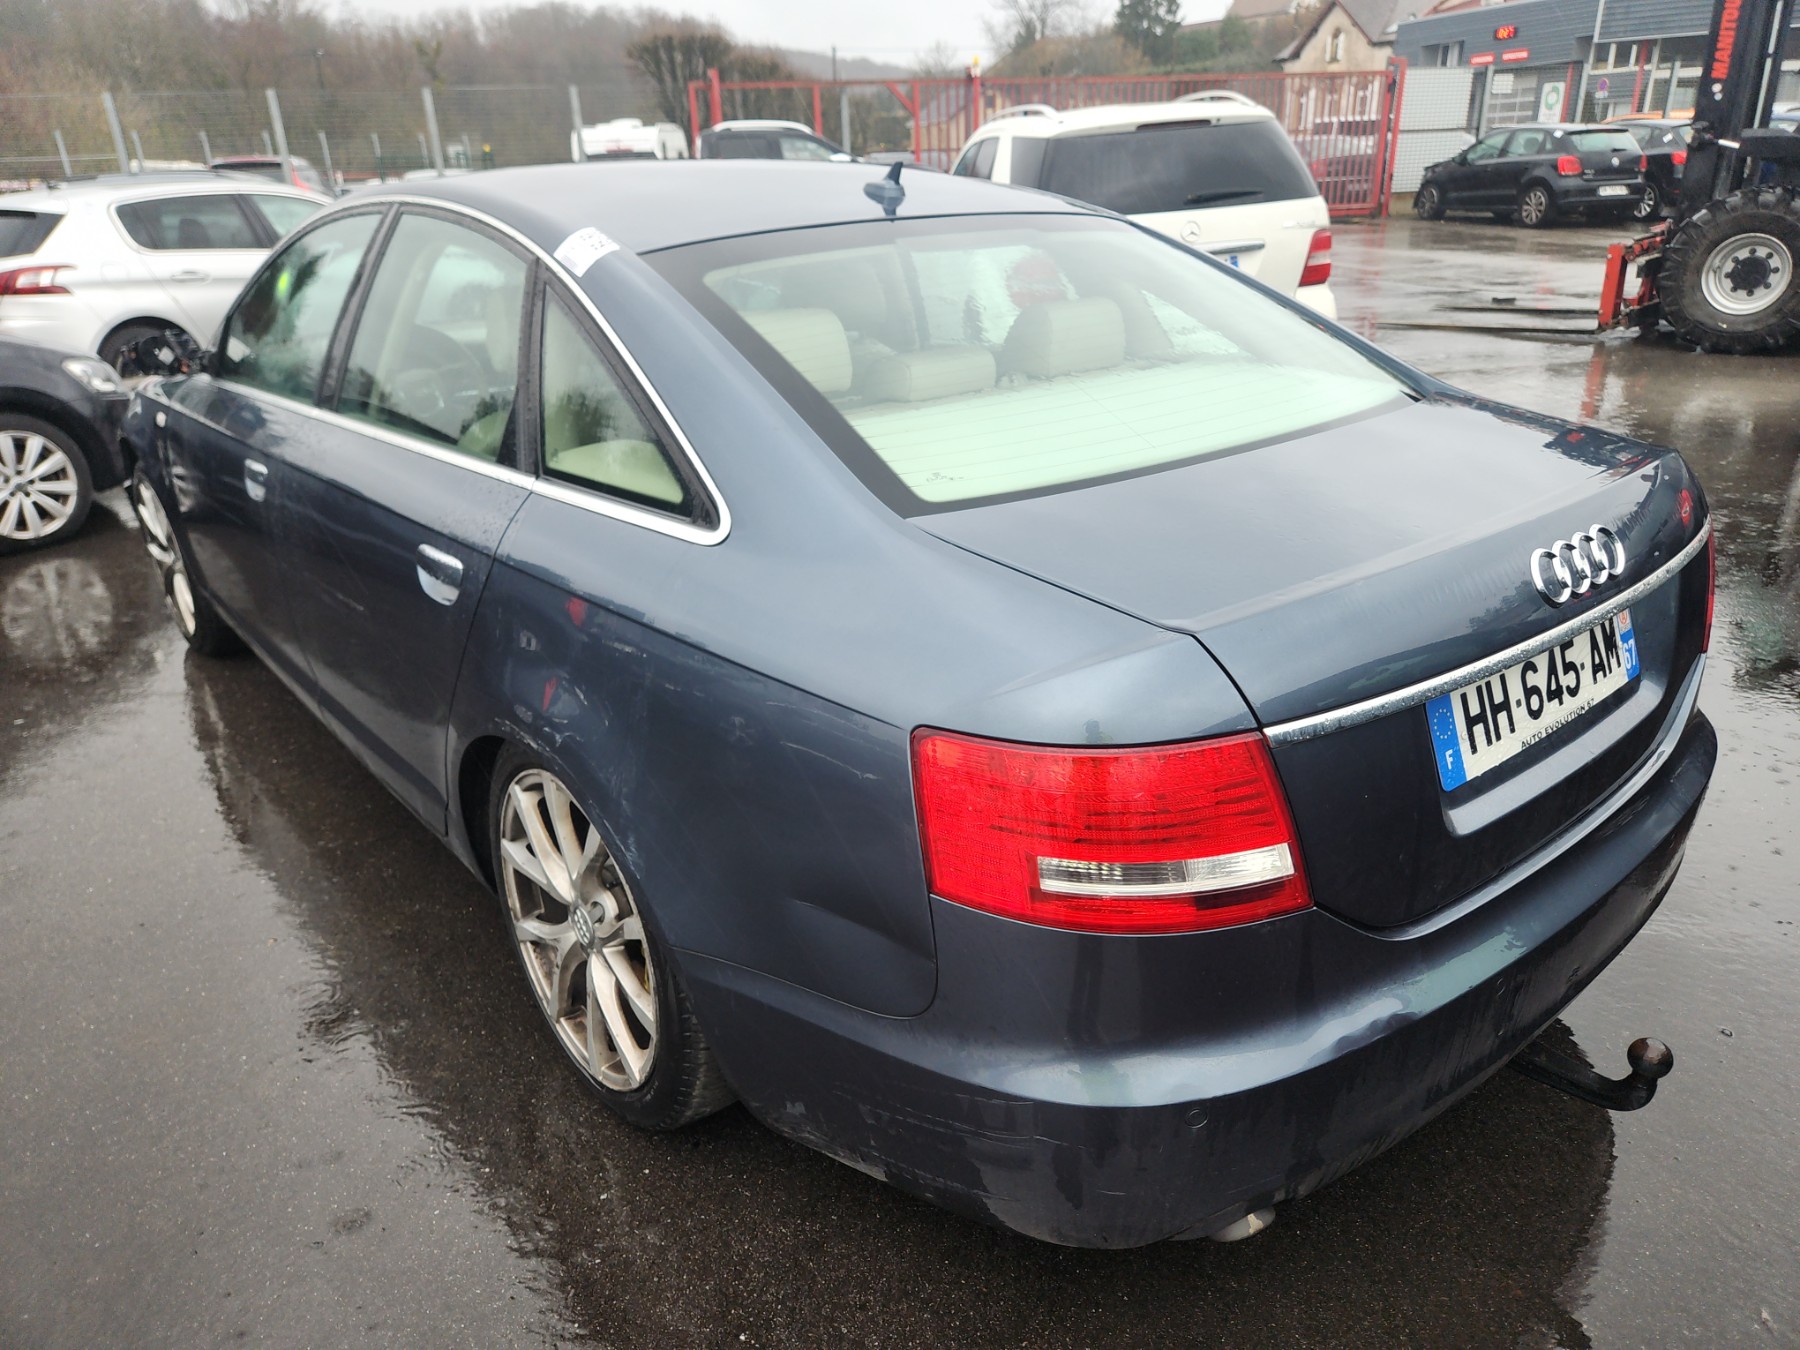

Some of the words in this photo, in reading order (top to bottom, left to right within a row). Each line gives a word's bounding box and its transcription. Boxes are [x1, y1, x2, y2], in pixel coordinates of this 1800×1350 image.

[1711, 0, 1741, 79] MANITOU
[1622, 638, 1636, 669] 67
[1460, 617, 1621, 755] HH-645-AM
[1521, 731, 1542, 749] AUTO
[1545, 704, 1585, 735] EVOLUTION
[1445, 749, 1454, 770] F
